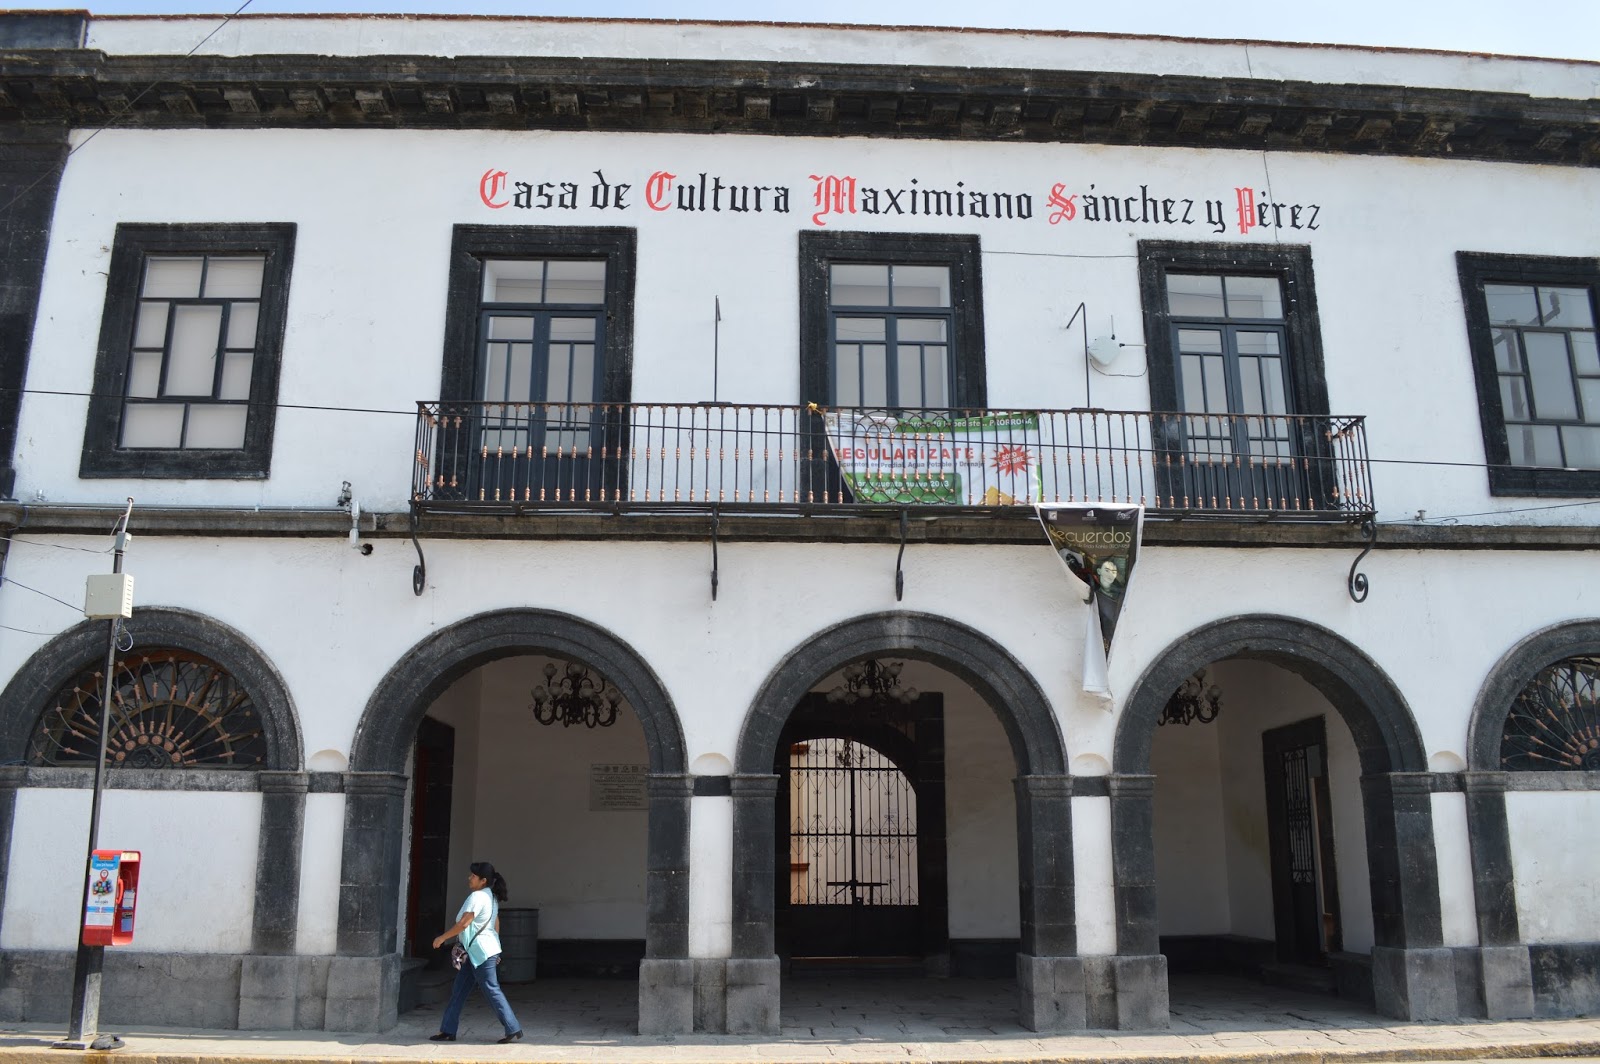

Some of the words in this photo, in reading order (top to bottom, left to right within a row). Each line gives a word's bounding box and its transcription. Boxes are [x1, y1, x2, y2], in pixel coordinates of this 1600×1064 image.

[479, 168, 578, 210] Casa
[589, 168, 632, 210] de
[645, 170, 790, 213] Cultura
[808, 174, 1033, 226] Maximiano
[1046, 182, 1196, 225] Sánchez
[1206, 199, 1226, 234] y
[1234, 187, 1321, 235] Pérez
